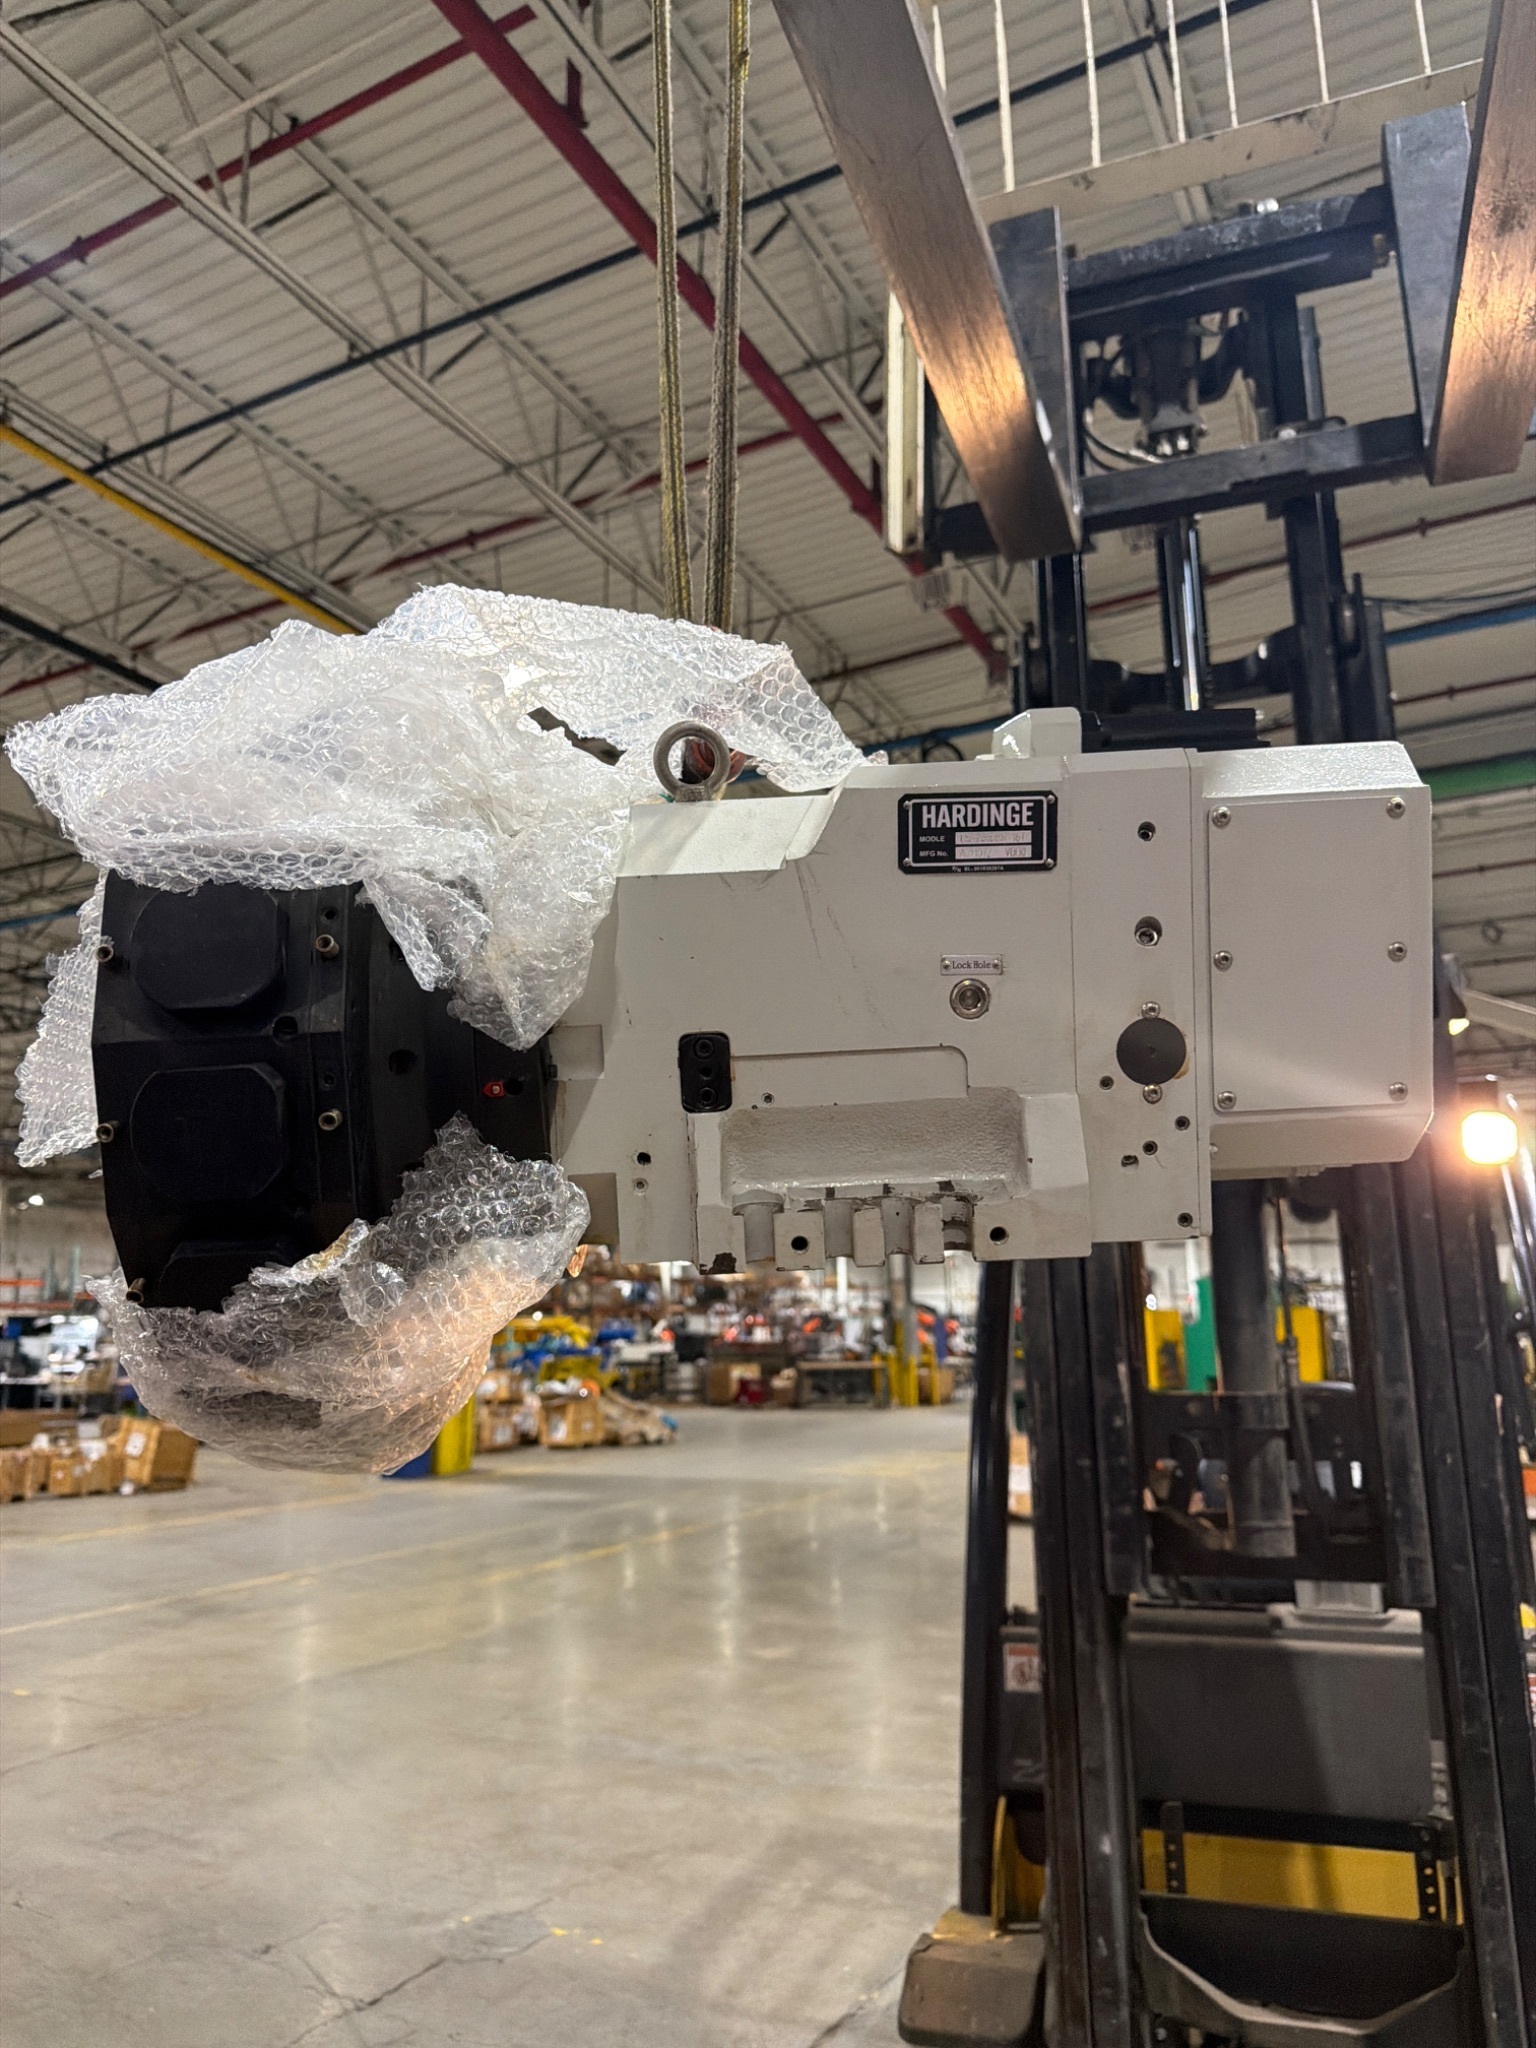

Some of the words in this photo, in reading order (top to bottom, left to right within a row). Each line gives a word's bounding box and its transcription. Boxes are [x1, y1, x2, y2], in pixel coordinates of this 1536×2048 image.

[922, 802, 1034, 828] HARDINGE
[952, 961, 972, 969] Lock
[973, 961, 992, 969] Hole
